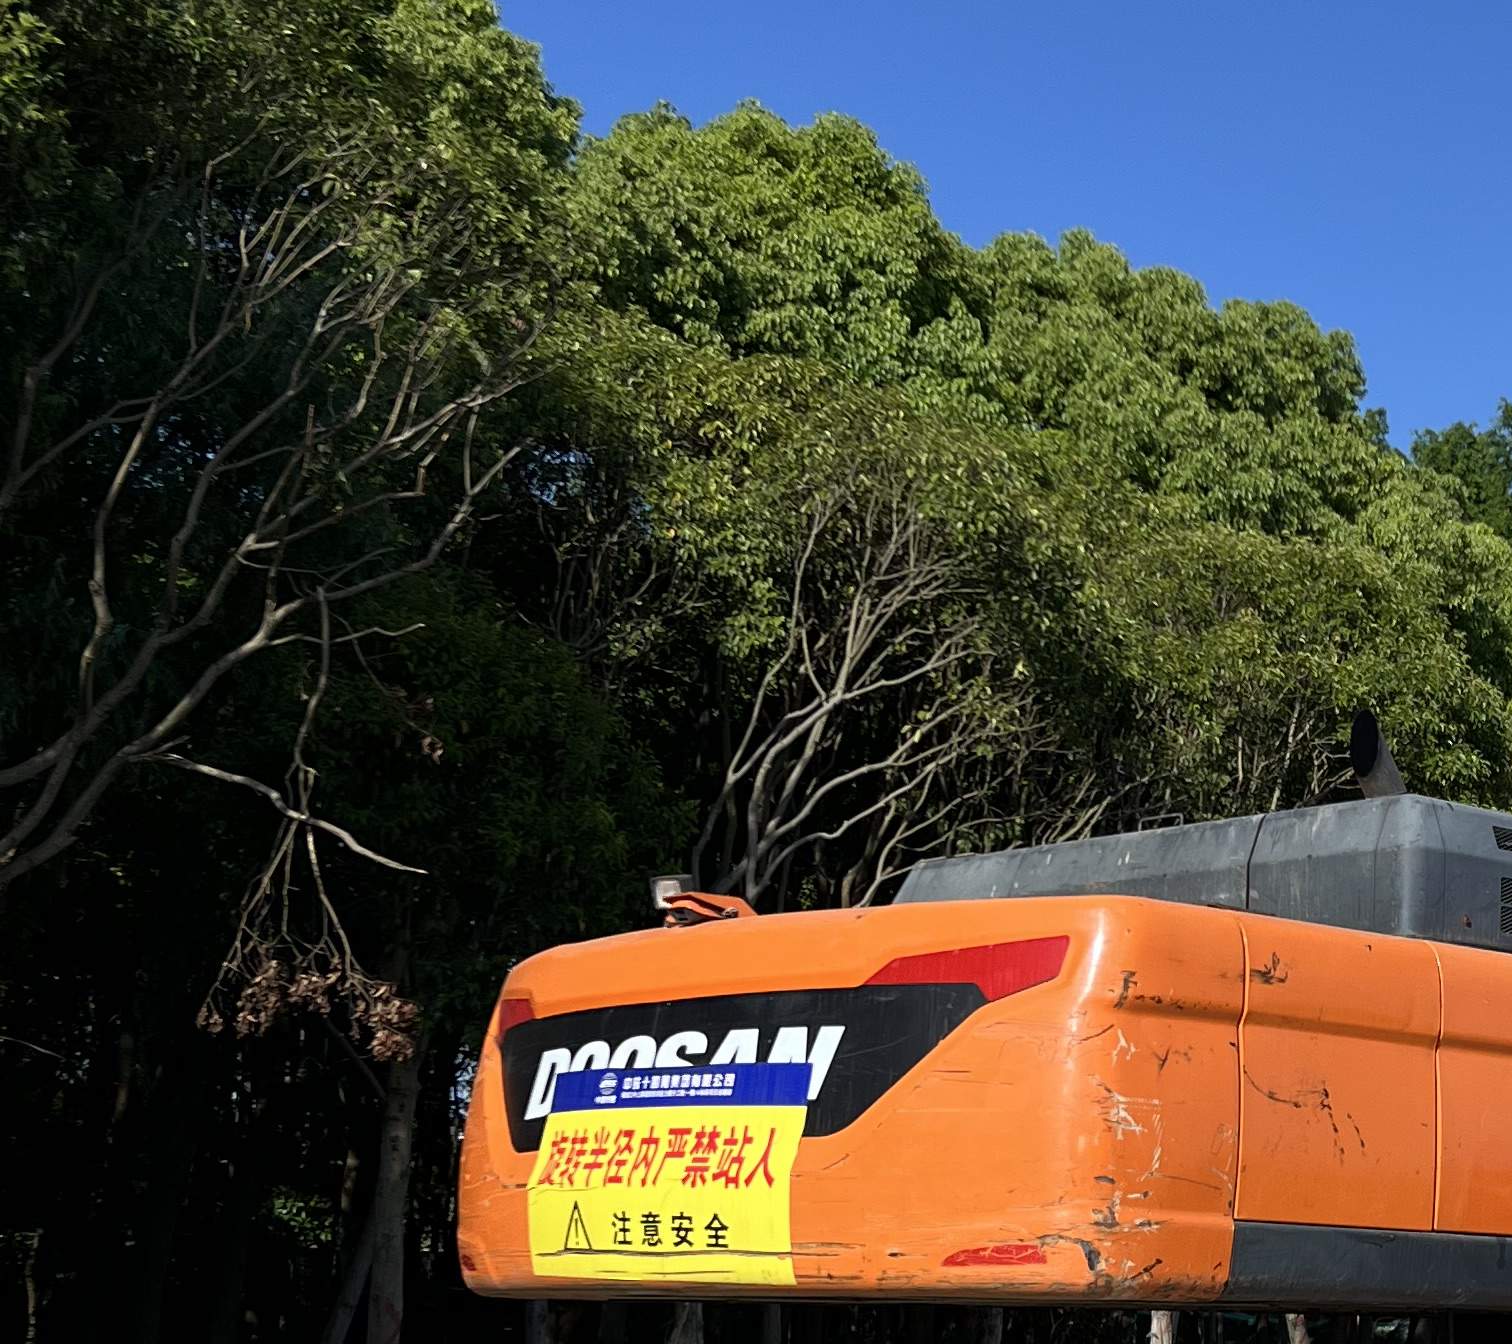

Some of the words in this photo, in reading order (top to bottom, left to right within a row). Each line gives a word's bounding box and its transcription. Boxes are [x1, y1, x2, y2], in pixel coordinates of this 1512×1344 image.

[538, 1126, 776, 1189] 旋转半径内严禁站人
[611, 1210, 730, 1249] 注意安全
